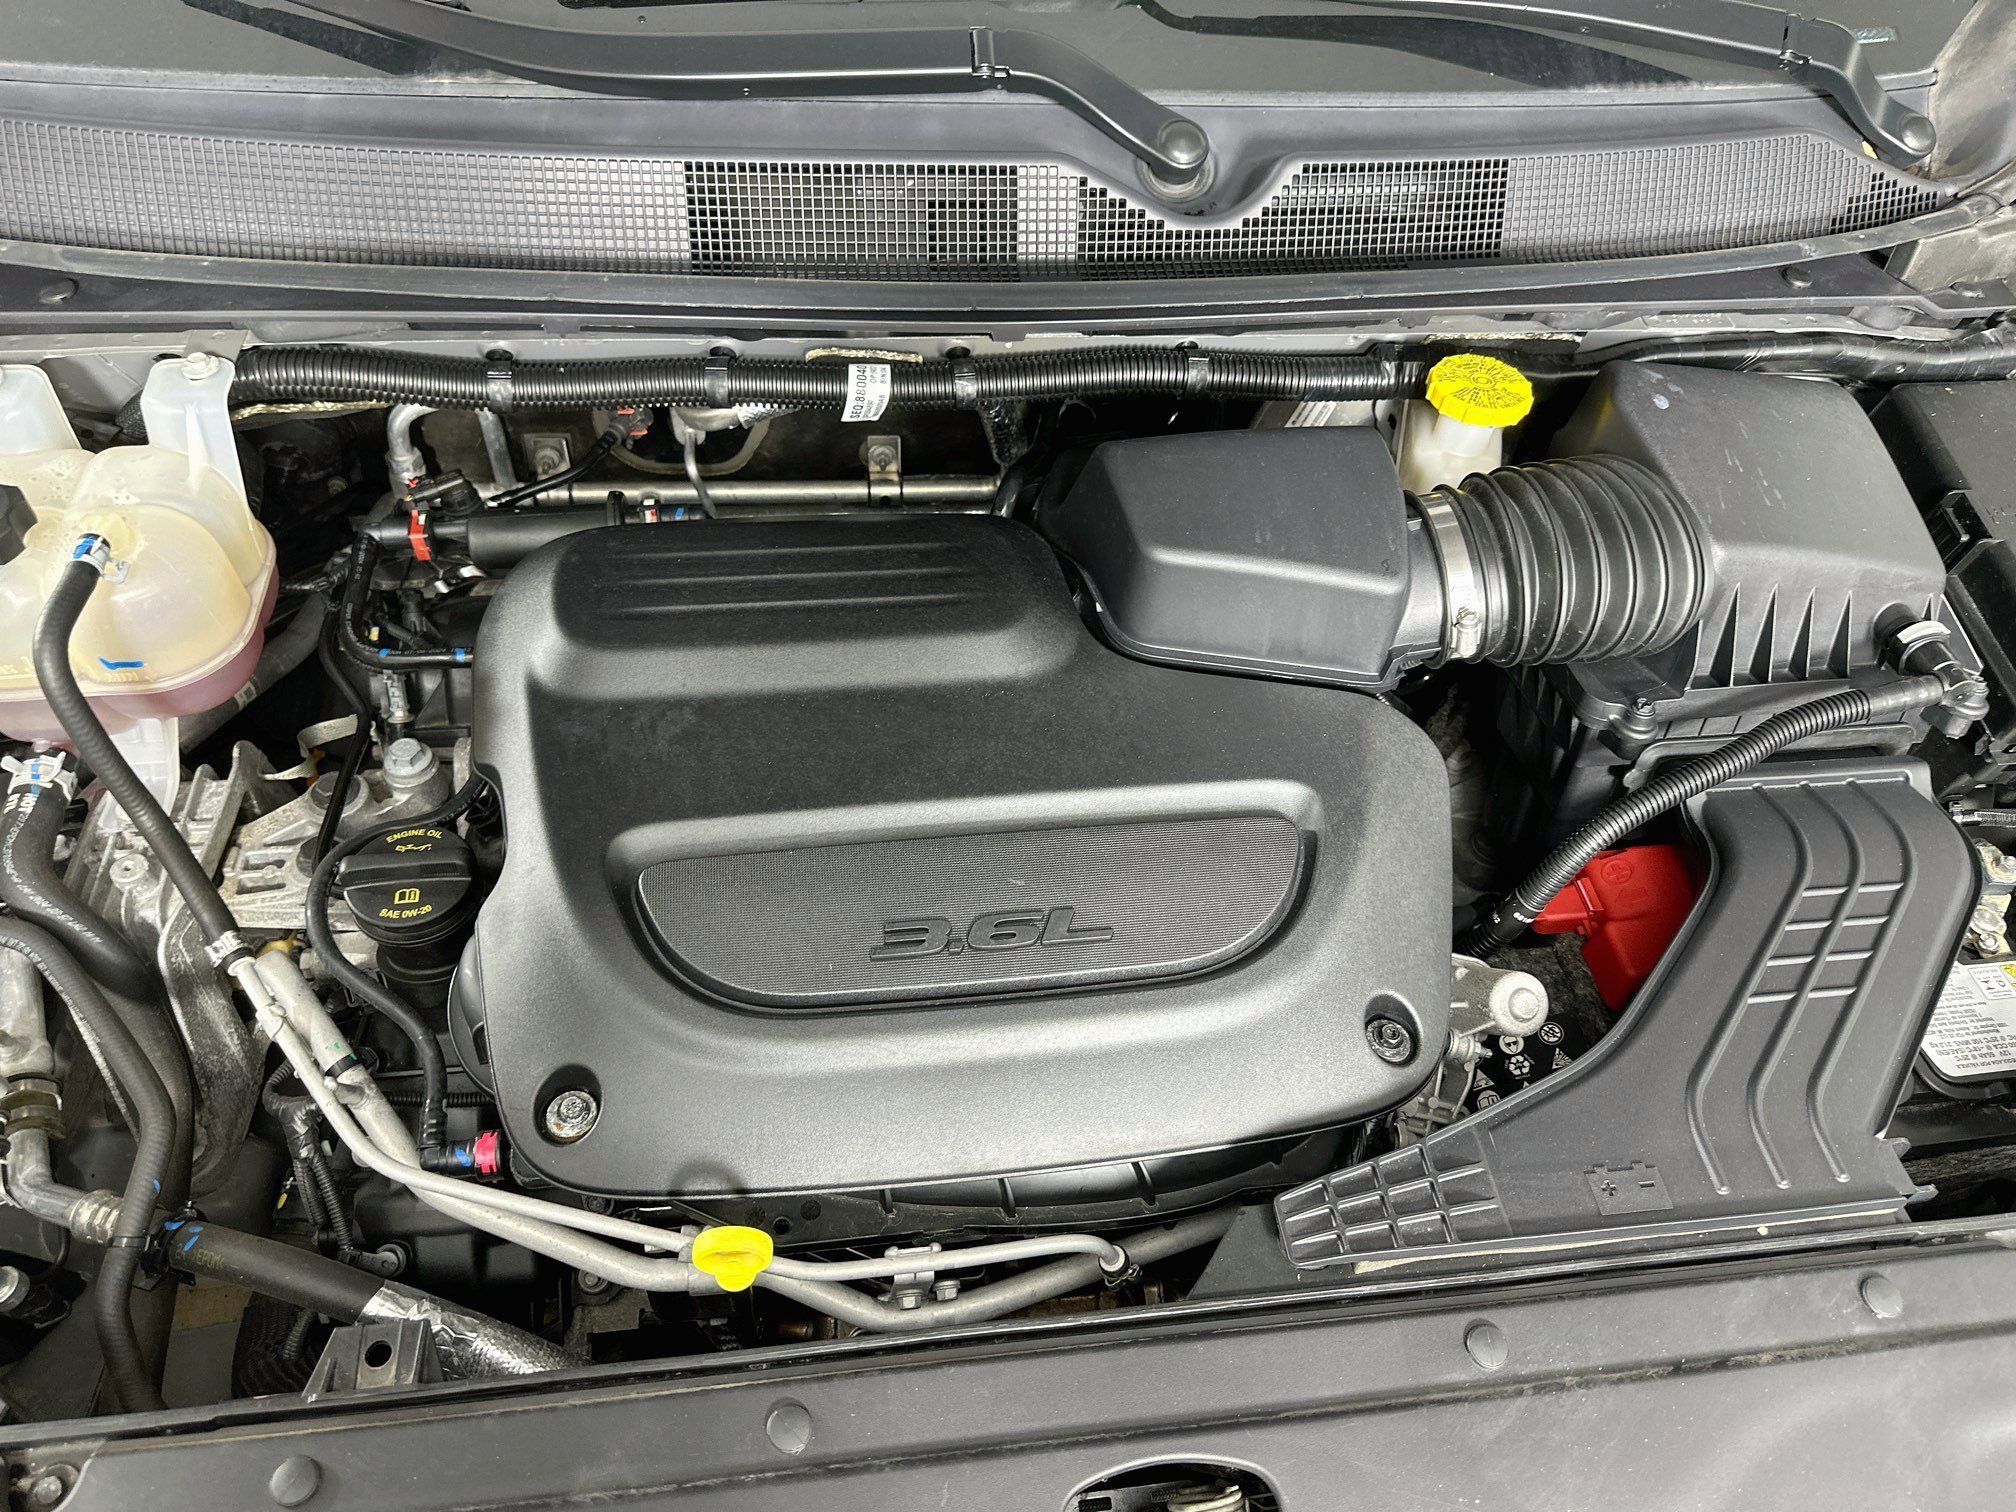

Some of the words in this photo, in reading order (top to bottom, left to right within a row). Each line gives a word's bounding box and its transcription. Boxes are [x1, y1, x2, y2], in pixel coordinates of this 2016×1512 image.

[850, 365, 867, 419] SEQ:880040
[386, 828, 426, 843] ENGINE
[427, 829, 442, 839] OIL
[379, 908, 400, 919] SAE
[402, 904, 432, 919] 0W-20
[869, 904, 1115, 962] 3.6L
